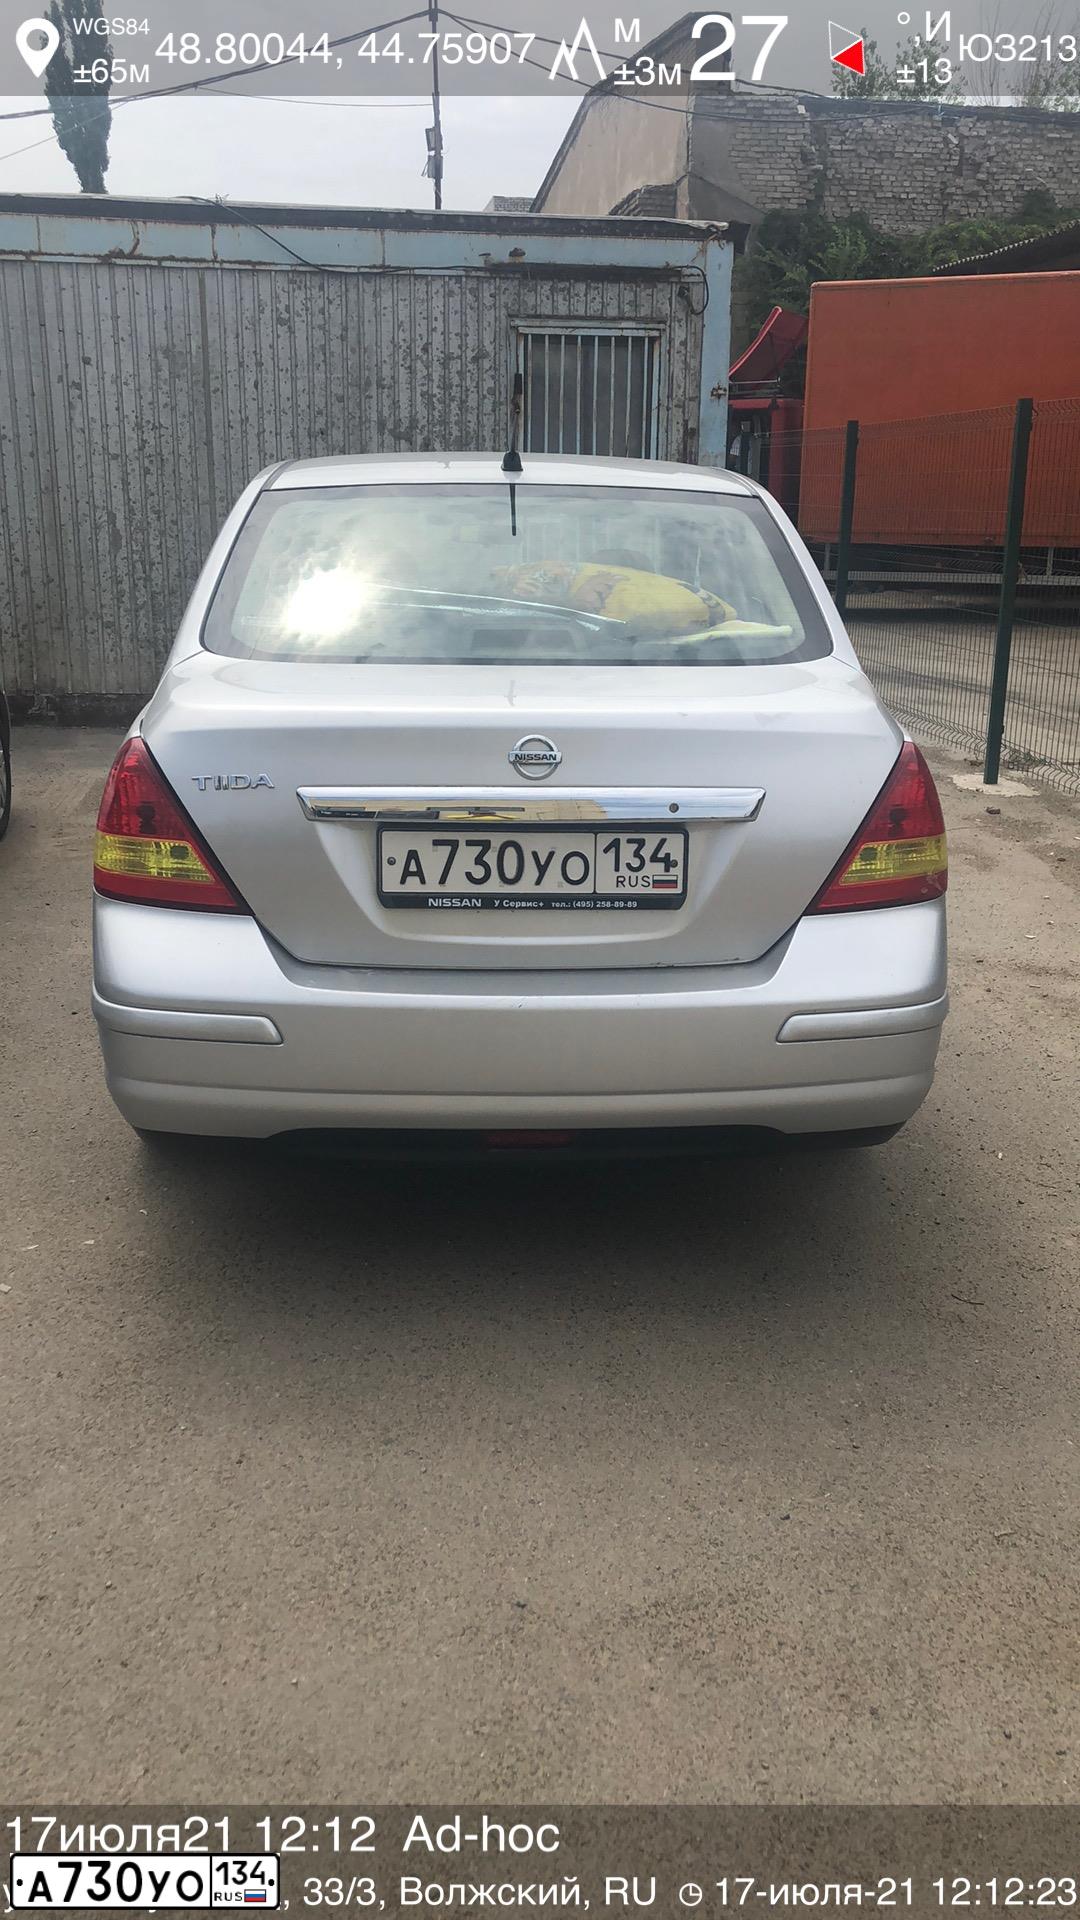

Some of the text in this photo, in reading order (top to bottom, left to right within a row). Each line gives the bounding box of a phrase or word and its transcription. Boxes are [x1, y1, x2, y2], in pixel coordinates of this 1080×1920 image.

[514, 753, 557, 761] NISSAN
[191, 773, 275, 791] TIIDA
[602, 837, 673, 873] 134
[615, 875, 651, 888] RUS
[428, 898, 482, 908] NISSAN
[572, 900, 594, 910] (495)
